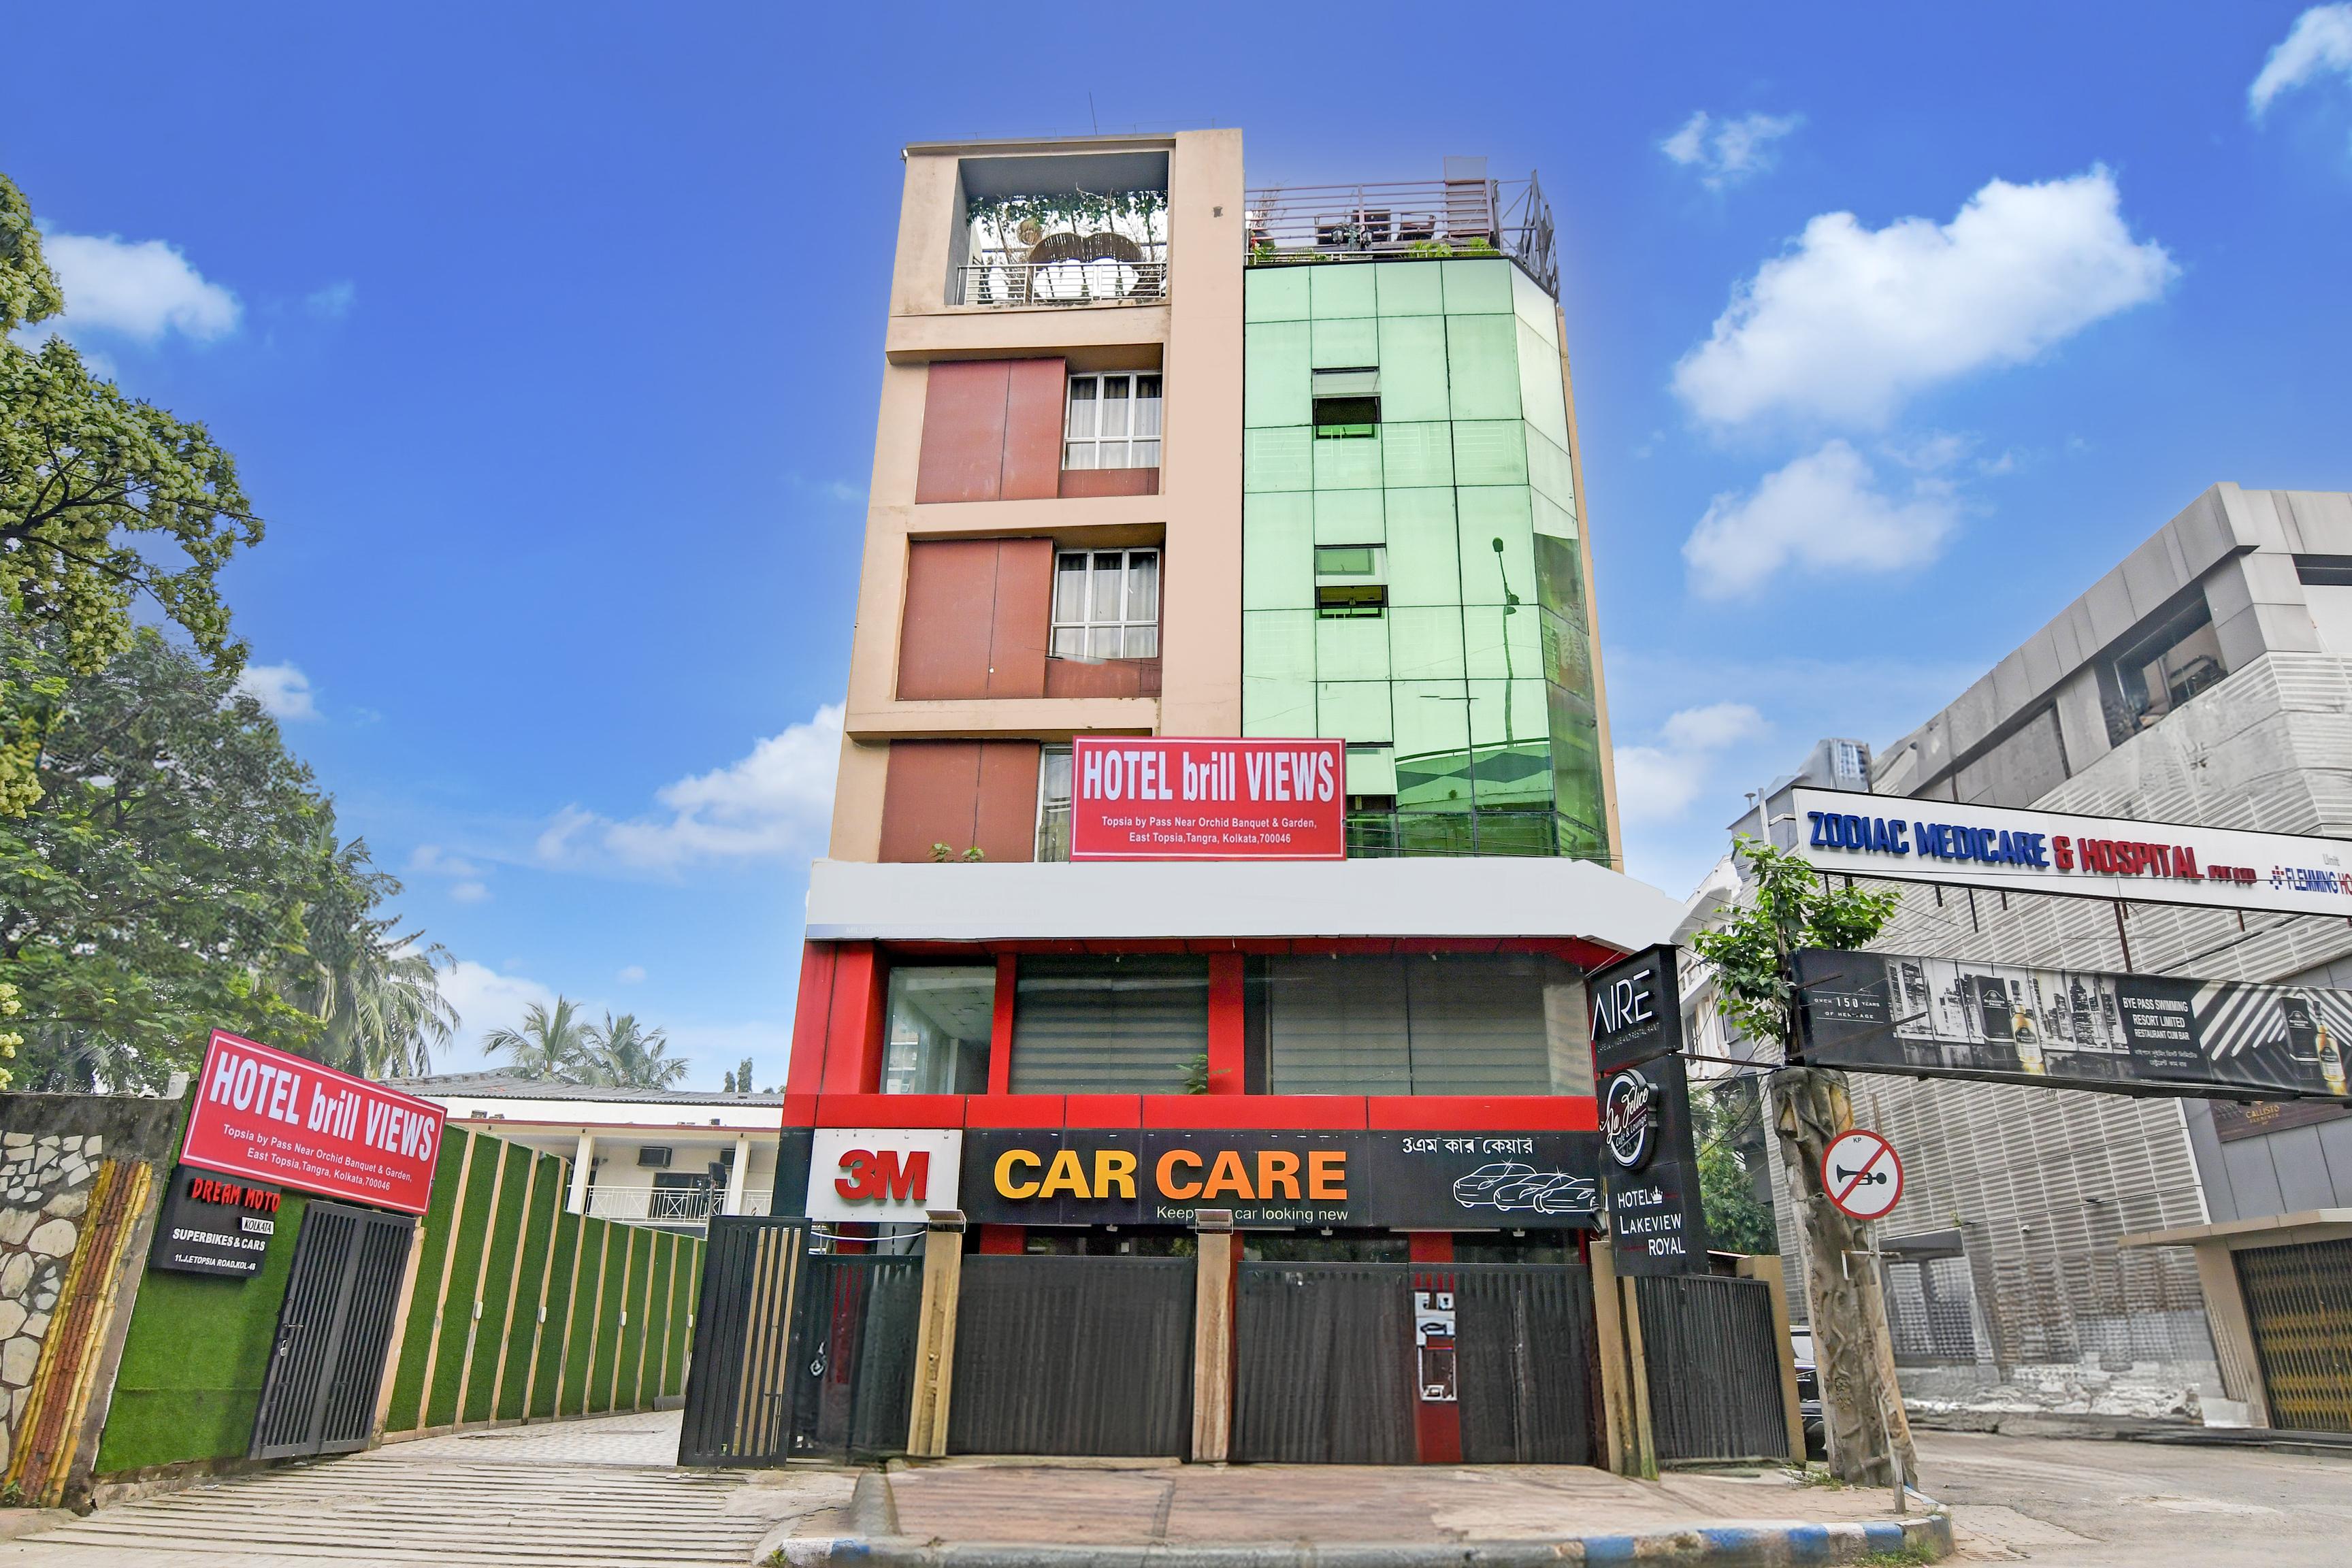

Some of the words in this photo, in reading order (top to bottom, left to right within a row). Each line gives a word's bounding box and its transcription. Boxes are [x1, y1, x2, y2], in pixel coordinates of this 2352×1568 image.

[1083, 749, 1173, 801] HOTEL
[1182, 751, 1236, 802] brill
[1245, 751, 1335, 802] VIEWS
[1102, 816, 1132, 828] Topsia
[1135, 817, 1147, 828] by
[1149, 817, 1172, 827] Pass
[1175, 817, 1196, 827] Near
[1198, 817, 1229, 828] Orchid
[1232, 817, 1269, 830] Banquet
[1272, 818, 1279, 828] &
[1281, 817, 1317, 829] Garden,
[1129, 832, 1150, 842] East
[1222, 833, 1291, 844] Kolkata,700046
[1807, 811, 1910, 854] ZODIAC
[1914, 821, 2050, 868] MEDICARE
[2052, 836, 2074, 870] &
[2077, 838, 2205, 879] HOSPITAL
[2285, 867, 2338, 894] FLEMMING
[1590, 969, 1653, 1041] AIRE
[1836, 996, 1859, 1008] 150
[2122, 997, 2137, 1009] BYE
[2137, 998, 2155, 1010] PASS
[2155, 999, 2189, 1012] SWIMMING
[2132, 1014, 2159, 1026] RESORT
[2159, 1016, 2185, 1028] LIMITED
[2134, 1028, 2166, 1039] RESTAURANT
[2167, 1030, 2178, 1040] CUM
[2178, 1032, 2190, 1041] BAR
[209, 1051, 301, 1125] HOTEL
[307, 1081, 361, 1141] brill
[365, 1098, 436, 1162] VIEWS
[2246, 1105, 2280, 1119] CALLISTO
[1630, 1114, 1648, 1134] Lounge
[223, 1124, 255, 1141] Topsia
[257, 1133, 269, 1146] by
[271, 1137, 292, 1151] Pass
[294, 1143, 314, 1156] Near
[316, 1149, 343, 1164] Orchid
[345, 1157, 376, 1173] Banquet
[378, 1165, 383, 1174] &
[385, 1167, 412, 1183] Garden,
[247, 1147, 268, 1161] East
[333, 1169, 391, 1191] Kolkata,700046
[834, 1149, 930, 1200] 3M
[993, 1149, 1137, 1200] CAR
[1155, 1149, 1348, 1200] CARE
[191, 1177, 241, 1206] DREAM
[244, 1187, 282, 1213] MOTO
[1617, 1188, 1652, 1209] HOTEL
[1156, 1206, 1194, 1222] Keep
[1235, 1209, 1257, 1220] car
[1262, 1207, 1315, 1223] looking
[1319, 1209, 1348, 1220] new
[1619, 1213, 1682, 1235] LAKEVIEW
[244, 1219, 272, 1233] KOLKATA
[172, 1228, 234, 1247] SUPERBIKES
[233, 1237, 240, 1248] &
[242, 1239, 267, 1252] CARS
[1648, 1236, 1686, 1256] ROYAL
